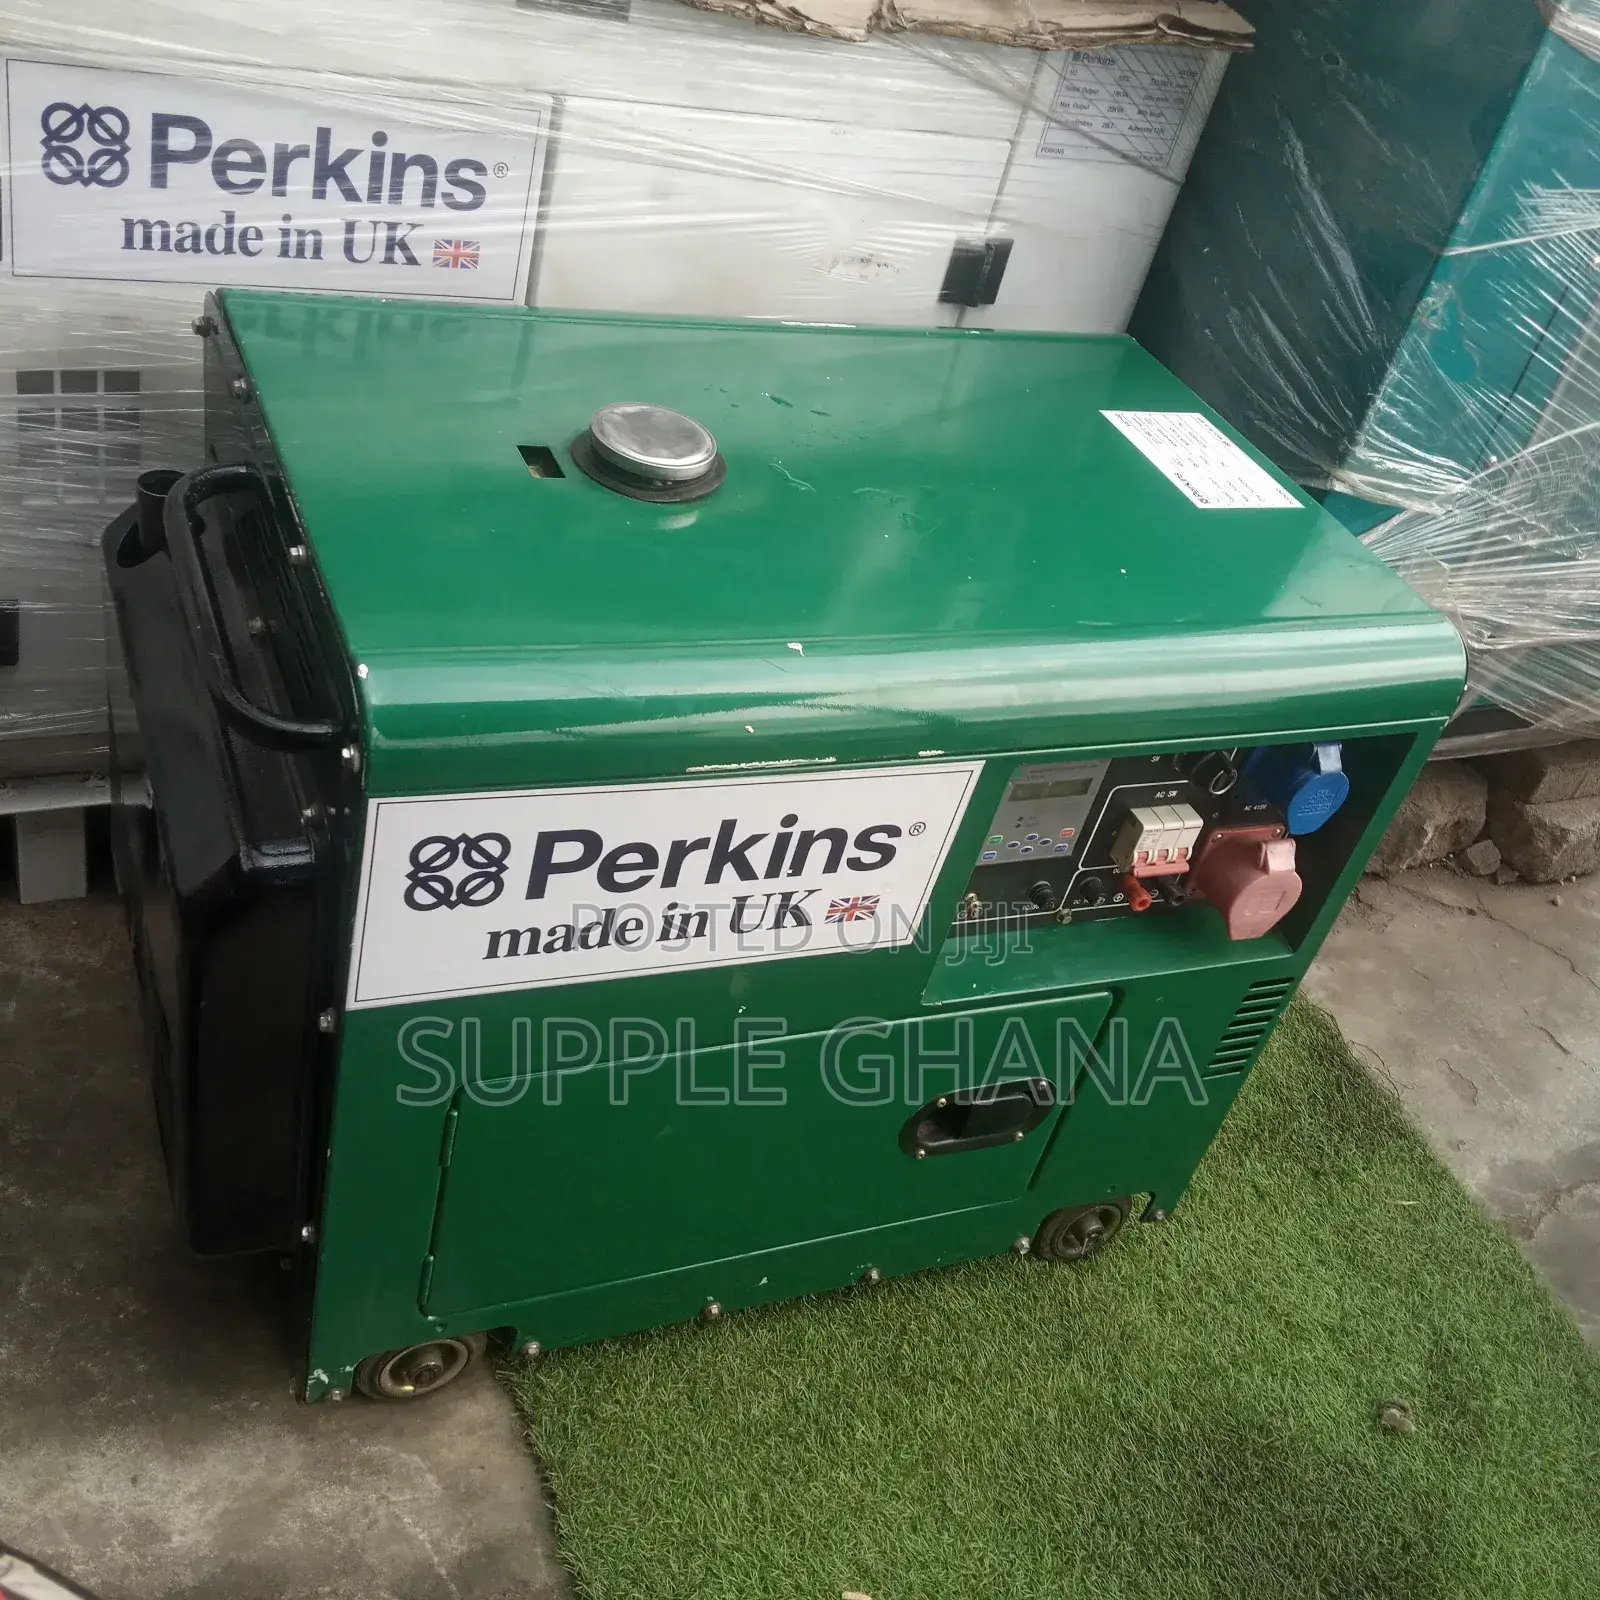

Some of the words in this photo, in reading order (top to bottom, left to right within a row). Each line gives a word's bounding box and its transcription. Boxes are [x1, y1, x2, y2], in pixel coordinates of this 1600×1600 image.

[121, 210, 263, 257] made
[278, 213, 324, 260] in
[340, 217, 424, 267] UK
[1154, 791, 1165, 799] AC
[1167, 790, 1179, 798] SW
[481, 908, 644, 961] made
[654, 901, 706, 943] in
[728, 888, 822, 934] UK
